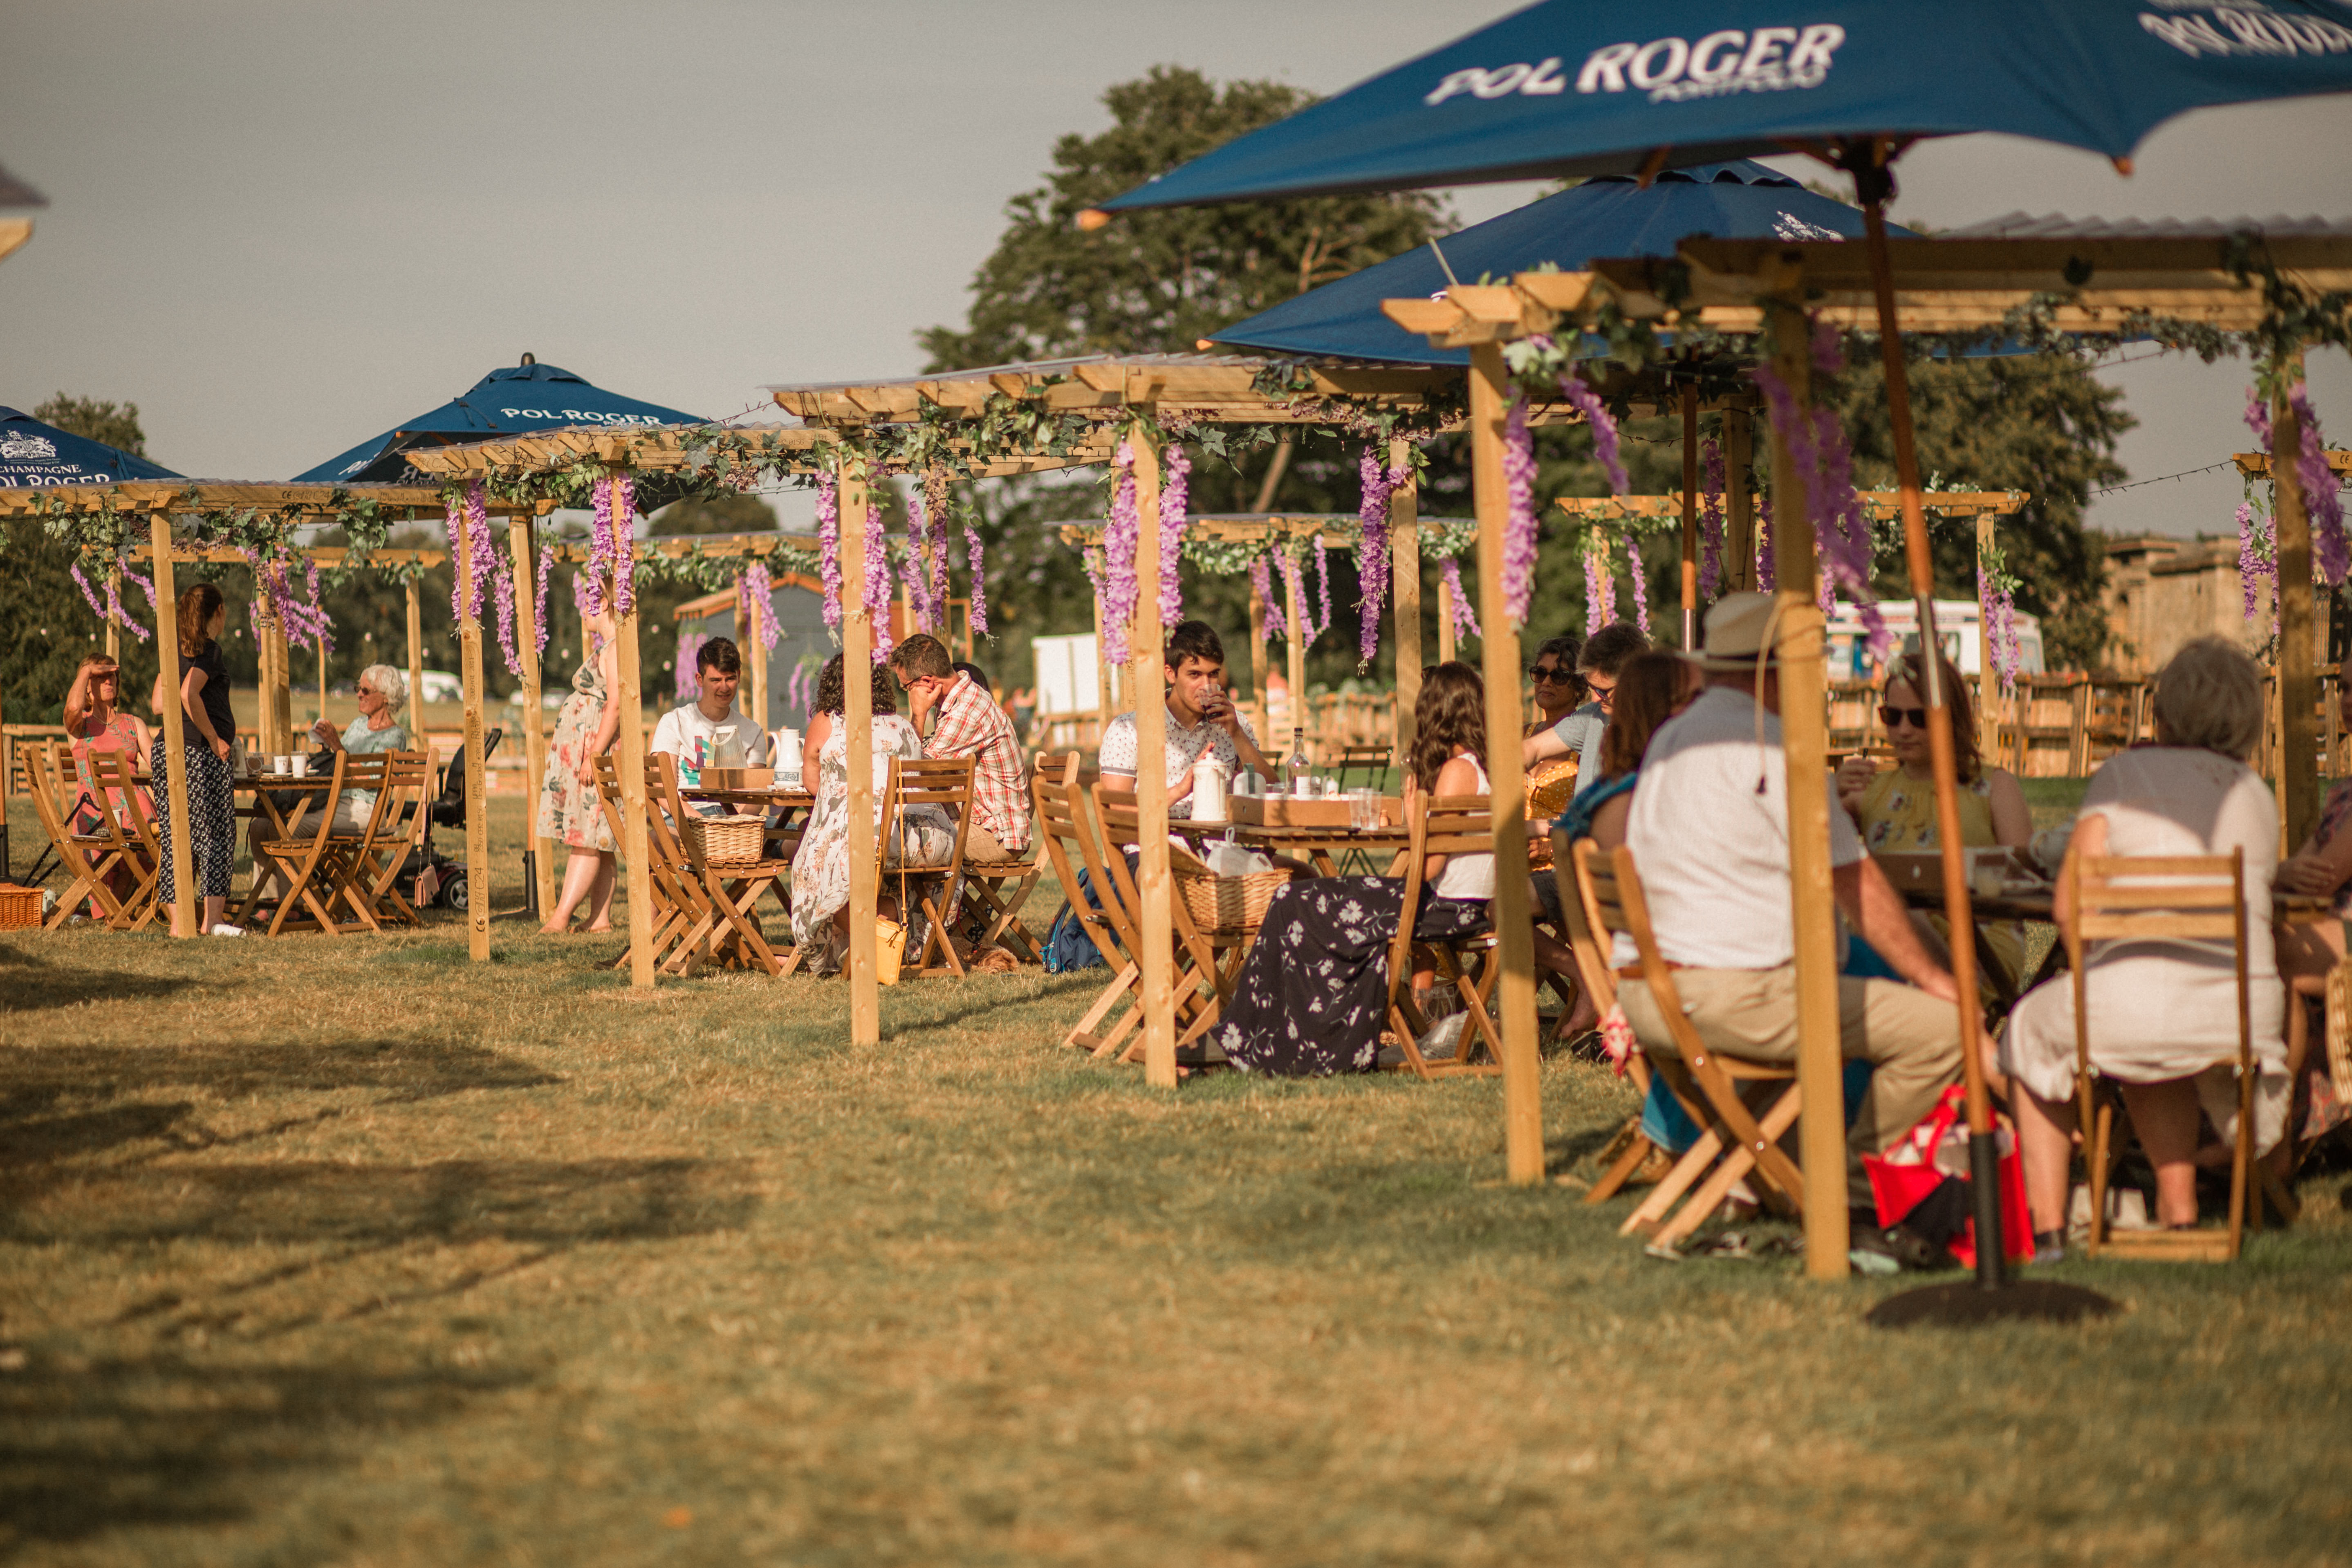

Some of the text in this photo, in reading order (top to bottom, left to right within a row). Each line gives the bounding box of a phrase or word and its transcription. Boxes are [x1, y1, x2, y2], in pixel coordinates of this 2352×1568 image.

[1424, 23, 1846, 106] POL ROGER
[501, 408, 665, 426] POL ROGER
[432, 458, 446, 468] C2
[2340, 455, 2350, 464] CE
[282, 491, 292, 499] CE
[474, 868, 484, 889] C24
[475, 919, 485, 933] CE
